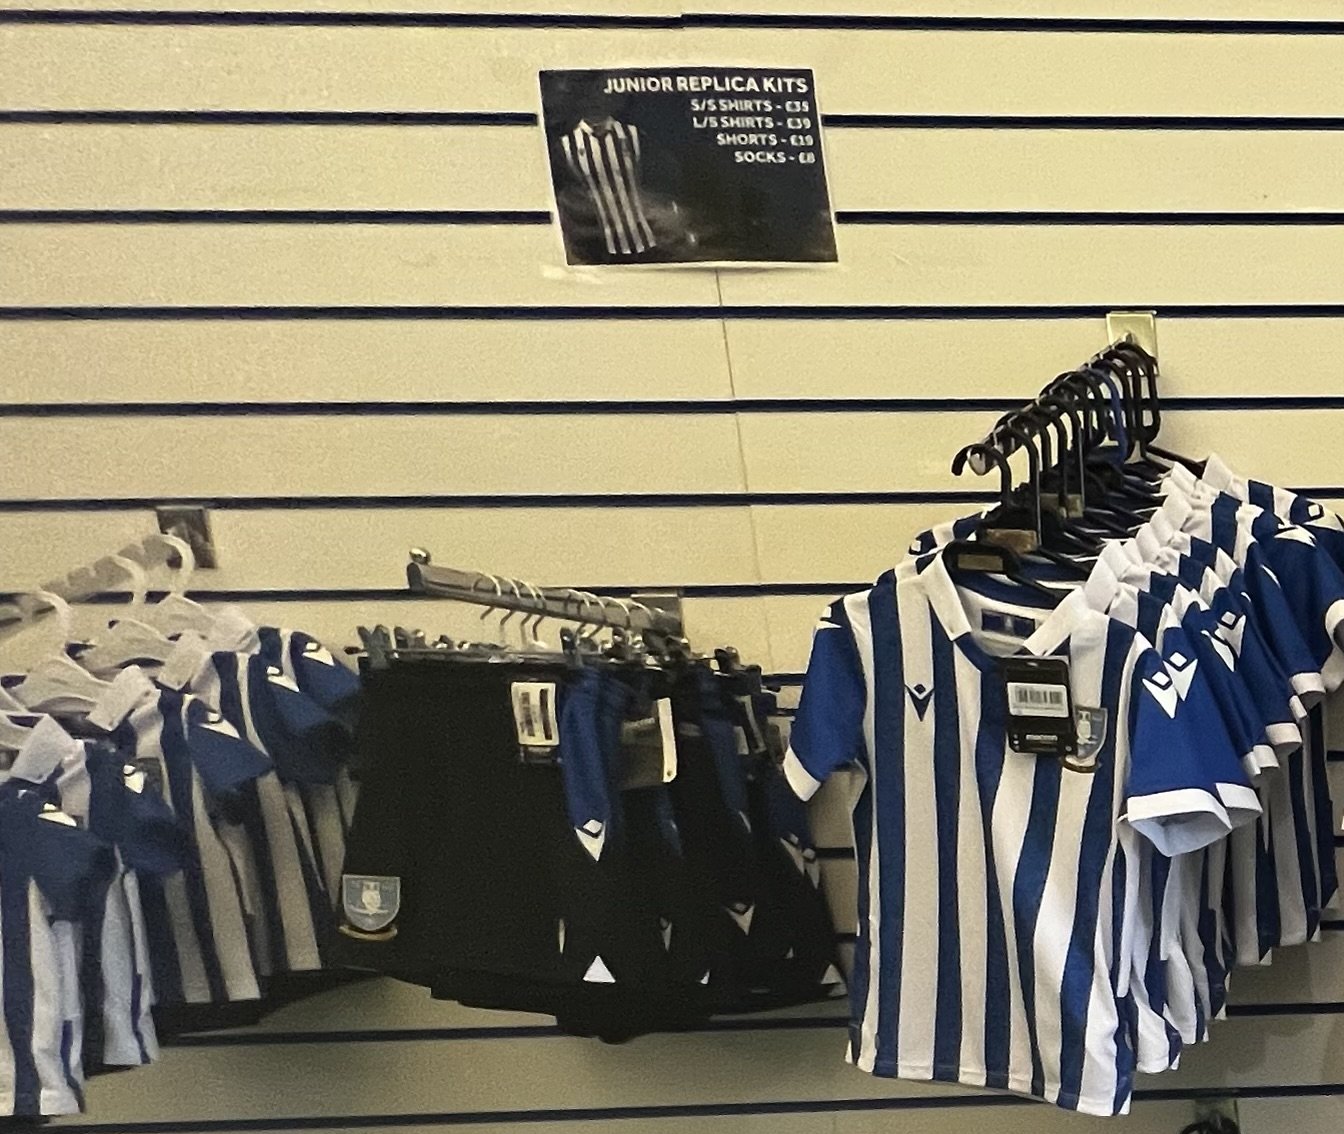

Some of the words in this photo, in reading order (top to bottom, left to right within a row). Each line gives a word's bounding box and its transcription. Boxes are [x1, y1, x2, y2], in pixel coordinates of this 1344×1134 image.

[603, 76, 675, 94] JUNIOR
[676, 77, 760, 93] REPLICA
[763, 77, 809, 93] KITS
[718, 99, 773, 112] SHIRTS
[720, 116, 774, 129] SHIRTS
[716, 133, 778, 146] SHORTS
[734, 151, 786, 163] SOCKS
